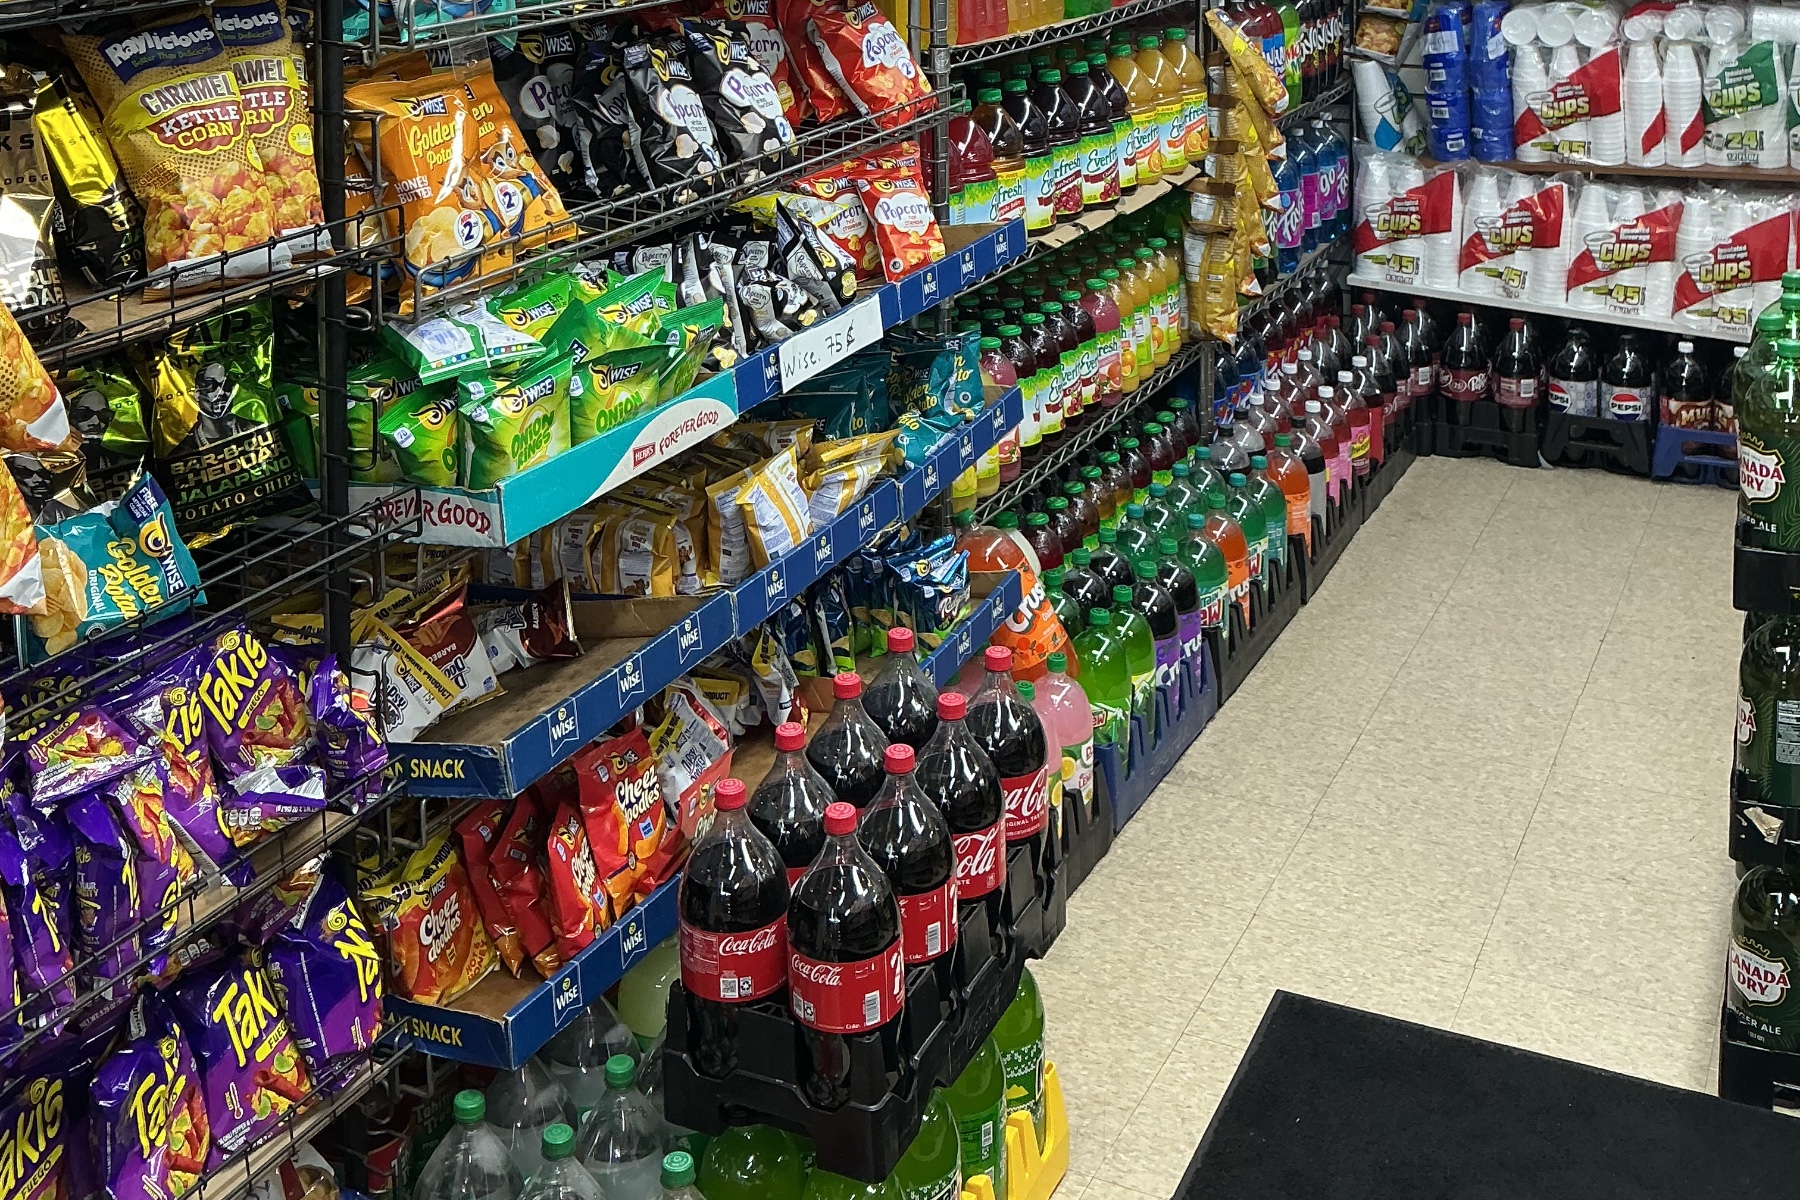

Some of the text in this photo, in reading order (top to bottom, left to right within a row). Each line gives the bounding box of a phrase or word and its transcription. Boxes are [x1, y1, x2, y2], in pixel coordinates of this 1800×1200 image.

[747, 0, 769, 14] WISE
[859, 3, 876, 20] WISE
[545, 35, 573, 54] WISE
[731, 44, 747, 60] WISE
[670, 60, 688, 77] WISE
[139, 74, 237, 117] CARAMEL
[424, 97, 446, 113] WISE
[1709, 82, 1762, 108] CUPS
[1541, 97, 1590, 119] CUPS
[159, 104, 240, 138] KETTLE
[178, 121, 234, 146] CORN
[409, 121, 457, 156] Golden
[1725, 131, 1758, 150] 24
[426, 148, 453, 170] Pota
[1557, 140, 1586, 158] 45
[394, 176, 429, 192] HONEY
[894, 179, 915, 188] WISE
[398, 187, 433, 205] BUTTER
[878, 200, 930, 220] Popcorn
[1377, 213, 1421, 232] CUPS
[1489, 225, 1534, 245] CUPS
[996, 241, 1008, 254] WISE
[1599, 243, 1652, 262] CUPS
[960, 261, 976, 275] WISE
[1388, 254, 1414, 274] 45
[1699, 260, 1751, 282] CUPS
[1501, 266, 1522, 287] 45
[923, 281, 938, 295] WISE
[1611, 284, 1640, 305] 45
[528, 303, 556, 321] WISE
[628, 294, 653, 318] WISE
[1717, 307, 1747, 324] 45
[609, 364, 640, 382] WISE
[525, 377, 555, 398] WISE
[596, 391, 644, 433] ONION
[1611, 402, 1642, 413] PEPSI
[993, 415, 1005, 426] WISE
[510, 411, 555, 452] ONION
[170, 427, 282, 473] BAR-B-QUE
[517, 429, 551, 468] RINGS
[959, 444, 972, 456] WISE
[924, 475, 938, 489] WISE
[1741, 470, 1764, 492] DRY
[174, 470, 301, 522] POTATO CHIPS
[438, 500, 491, 534] GOOD
[860, 511, 874, 526] WISE
[1759, 521, 1777, 533] ALE
[816, 545, 832, 560] WISE
[107, 537, 165, 609] Golden
[160, 555, 185, 594] WISE
[88, 568, 108, 613] ORIGINAL
[392, 574, 445, 610] MORE PRODUCT
[767, 581, 785, 598] WISE
[992, 602, 1004, 615] WISE
[679, 631, 700, 650] WISE
[404, 652, 423, 672] MORE
[422, 671, 455, 699] PRODUCT
[405, 673, 422, 693] WISE
[620, 673, 642, 693] WISE
[243, 687, 266, 718] FUEGO
[42, 720, 72, 744] FUEGO
[552, 716, 576, 741] WISE
[411, 759, 466, 779] SNACK
[616, 765, 658, 810] Cheez
[431, 877, 446, 896] WISE
[420, 892, 460, 946] Cheez
[623, 931, 644, 952] WISE
[719, 924, 777, 956] Coca-Cola
[791, 953, 842, 986] Coca-Cola
[1737, 971, 1769, 996] DRY
[556, 987, 579, 1009] WISE
[412, 1021, 462, 1046] SNACK
[1761, 1024, 1782, 1035] ALE
